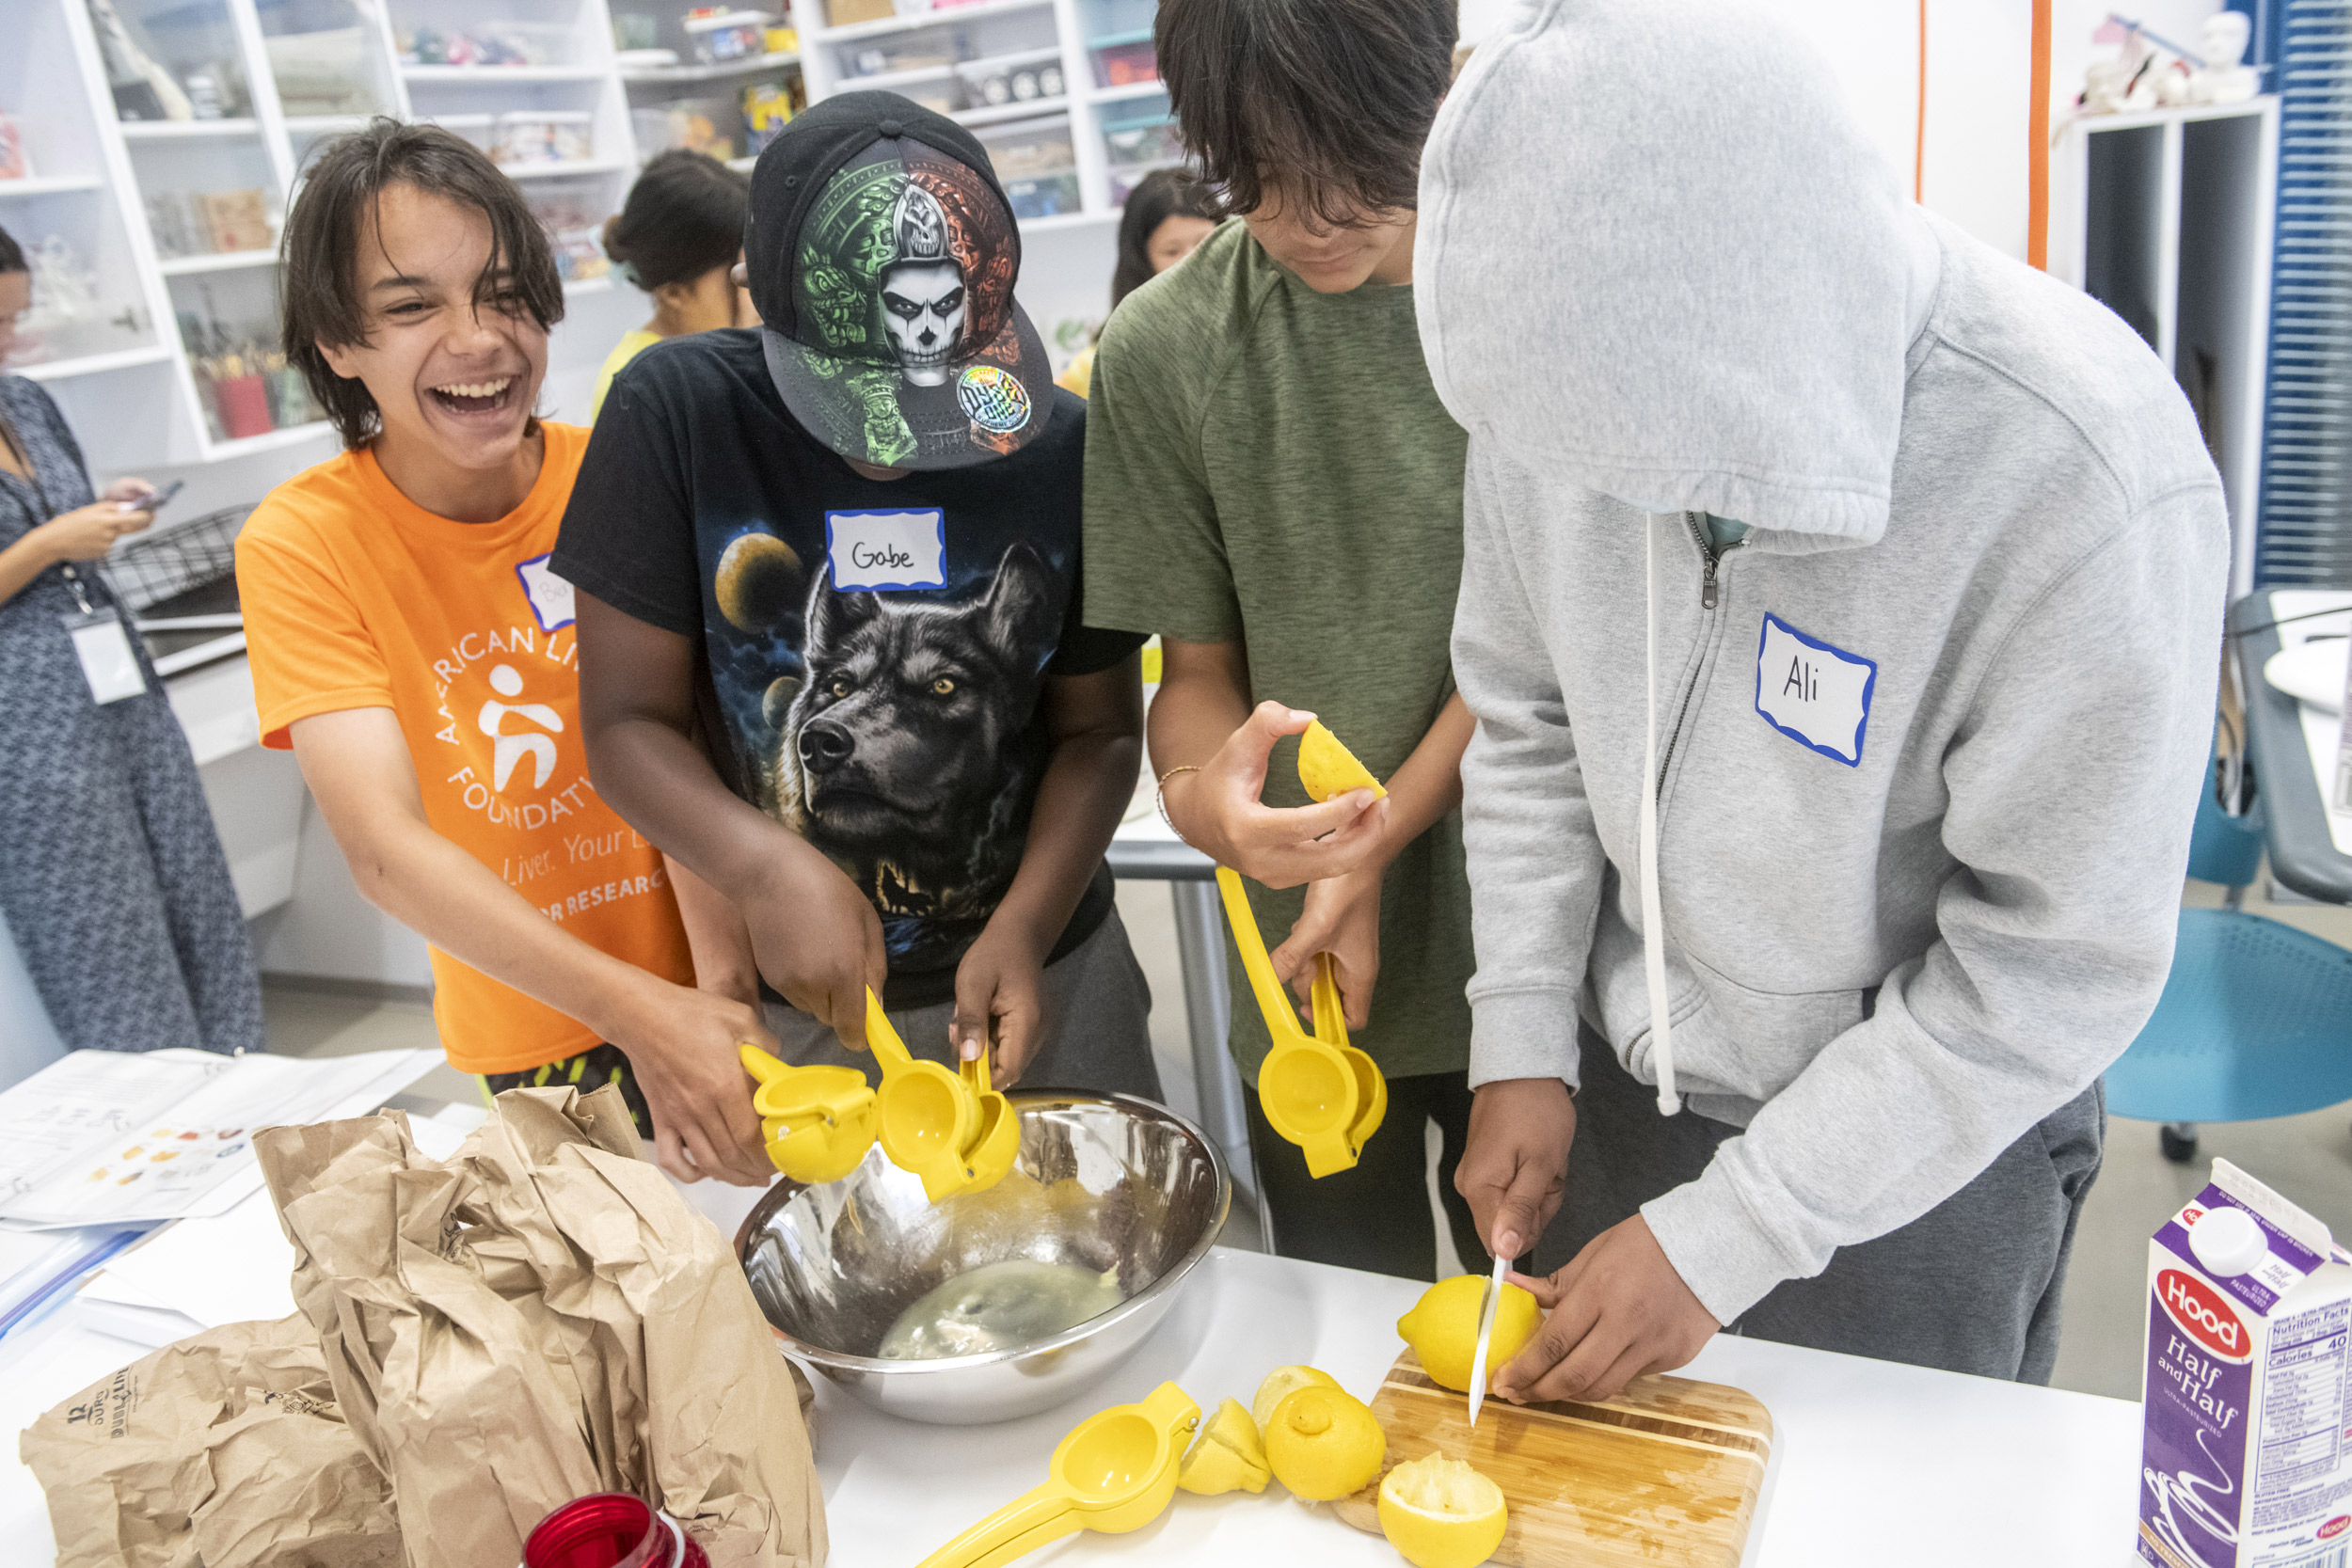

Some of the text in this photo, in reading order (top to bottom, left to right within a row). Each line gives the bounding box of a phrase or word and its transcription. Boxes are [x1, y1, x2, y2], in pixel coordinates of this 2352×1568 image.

[852, 542, 914, 569] Gabe
[1784, 655, 1818, 702] Ali
[563, 830, 624, 863] Your
[2231, 1279, 2266, 1307] PASTEURIZED
[2168, 1275, 2238, 1350] Hood
[2273, 1307, 2348, 1336] Nutrition Facts
[2167, 1335, 2222, 1389] Half
[2268, 1351, 2312, 1367] Calories
[2328, 1336, 2346, 1349] 40
[2158, 1356, 2238, 1429] and Half
[68, 1403, 87, 1424] 12
[2319, 1515, 2348, 1537] Hood
